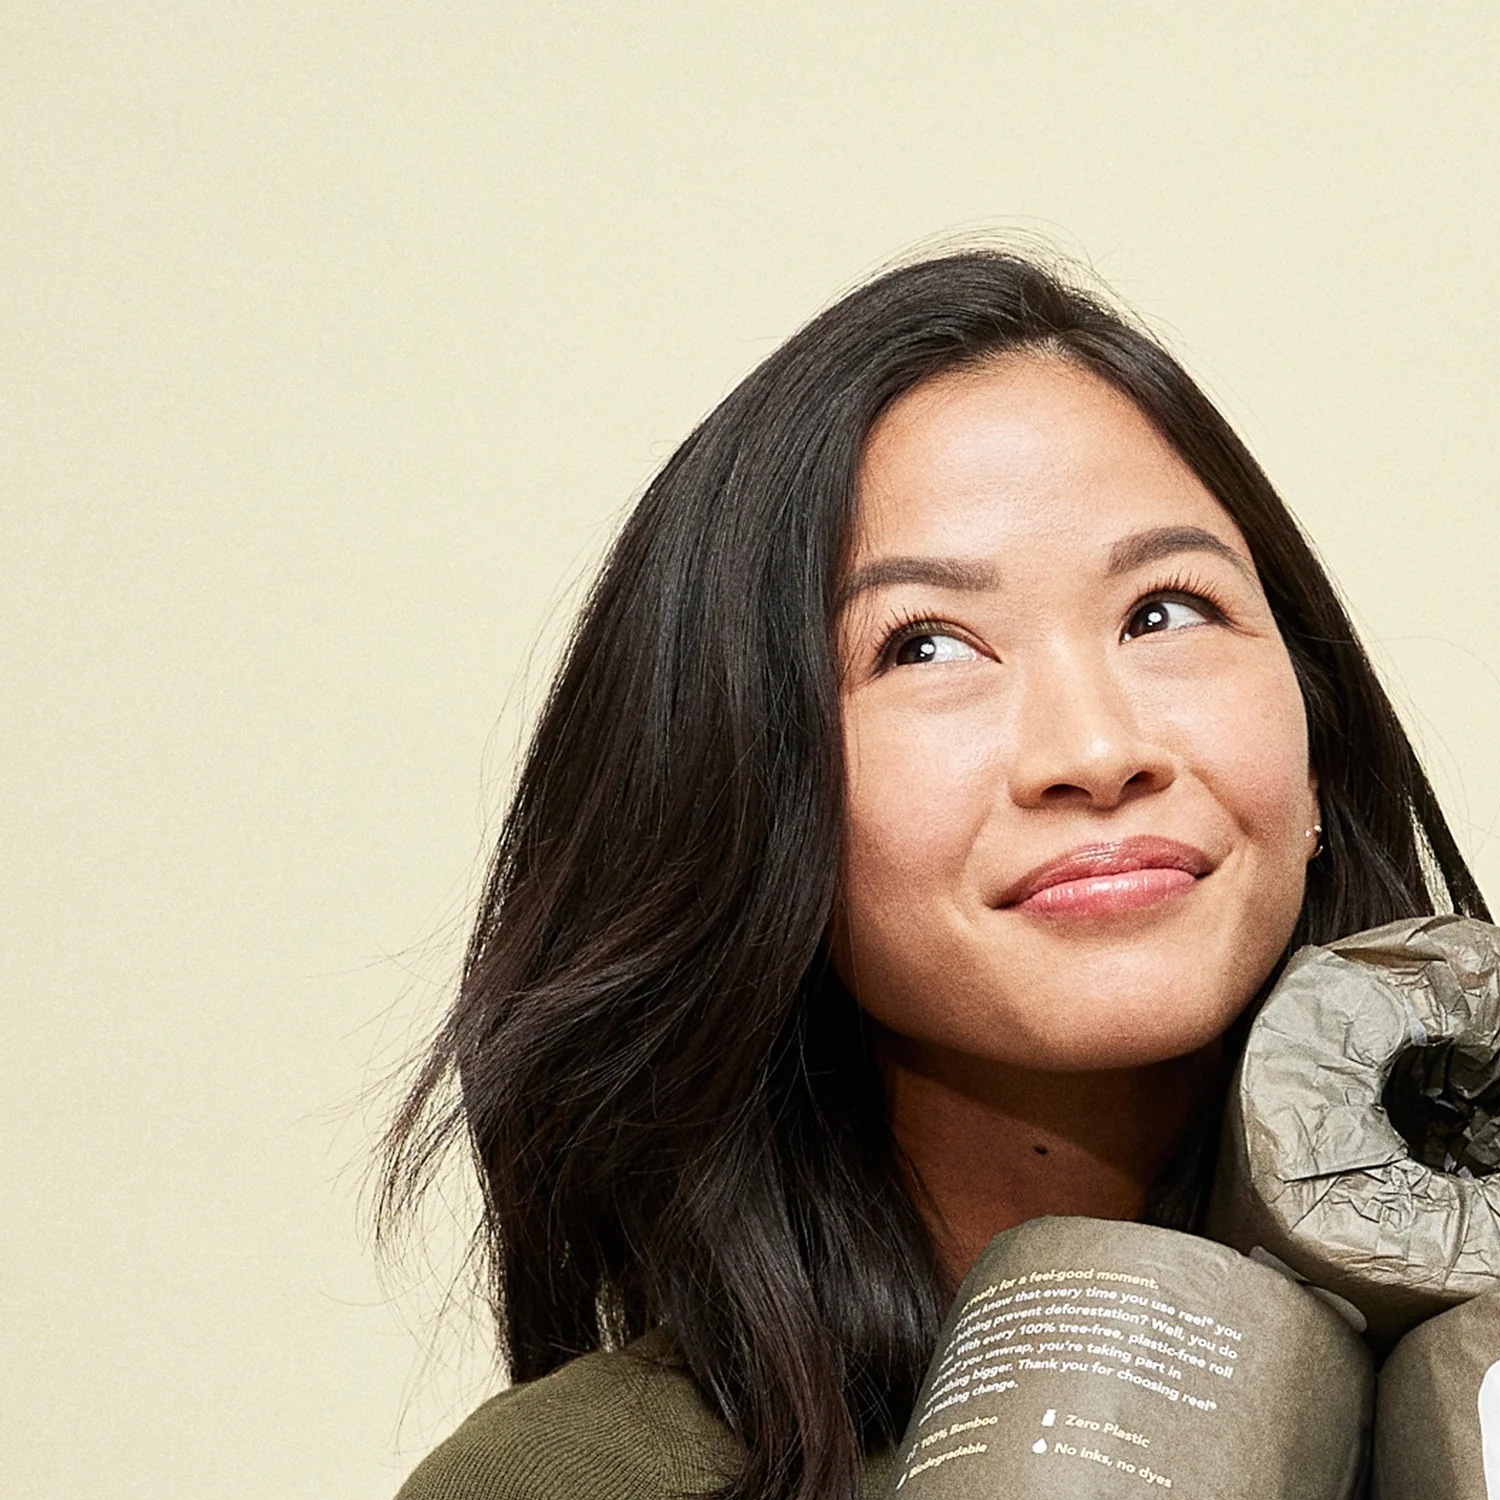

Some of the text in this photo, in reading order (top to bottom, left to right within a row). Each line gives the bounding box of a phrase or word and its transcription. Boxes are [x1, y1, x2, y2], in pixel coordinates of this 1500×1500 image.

[999, 1279, 1017, 1291] for
[1018, 1276, 1027, 1285] a
[1029, 1268, 1094, 1283] feel-good
[1096, 1270, 1159, 1290] moment.
[981, 1296, 1013, 1314] know
[1015, 1288, 1040, 1302] that
[1043, 1286, 1082, 1299] every
[1086, 1286, 1117, 1300] time
[1119, 1292, 1148, 1306] you
[1151, 1300, 1176, 1316] use
[1214, 1323, 1243, 1342] you
[993, 1308, 1042, 1329] prevent
[1044, 1303, 1149, 1327] deforestation?
[1151, 1317, 1185, 1341] Well,
[1187, 1333, 1216, 1351] you
[1218, 1344, 1238, 1360] do
[960, 1354, 984, 1371] you
[985, 1342, 1034, 1360] unwrap,
[1087, 1342, 1132, 1364] taking
[1134, 1355, 1166, 1375] part
[1168, 1365, 1182, 1380] in
[982, 1327, 1016, 1346] every
[1019, 1322, 1056, 1336] 100%
[1059, 1322, 1125, 1341] tree-free,
[1128, 1333, 1206, 1369] plastic-free
[1208, 1362, 1234, 1379] roll
[971, 1379, 1019, 1396] change.
[972, 1361, 1013, 1381] bigger.
[1018, 1357, 1058, 1371] Thank
[1060, 1360, 1088, 1373] you
[1091, 1361, 1114, 1377] for
[1116, 1368, 1180, 1401] choosing
[949, 1415, 999, 1437] Bamboo
[1065, 1413, 1150, 1449] Zero Plastic
[1054, 1442, 1172, 1489] No inks, no dyes
